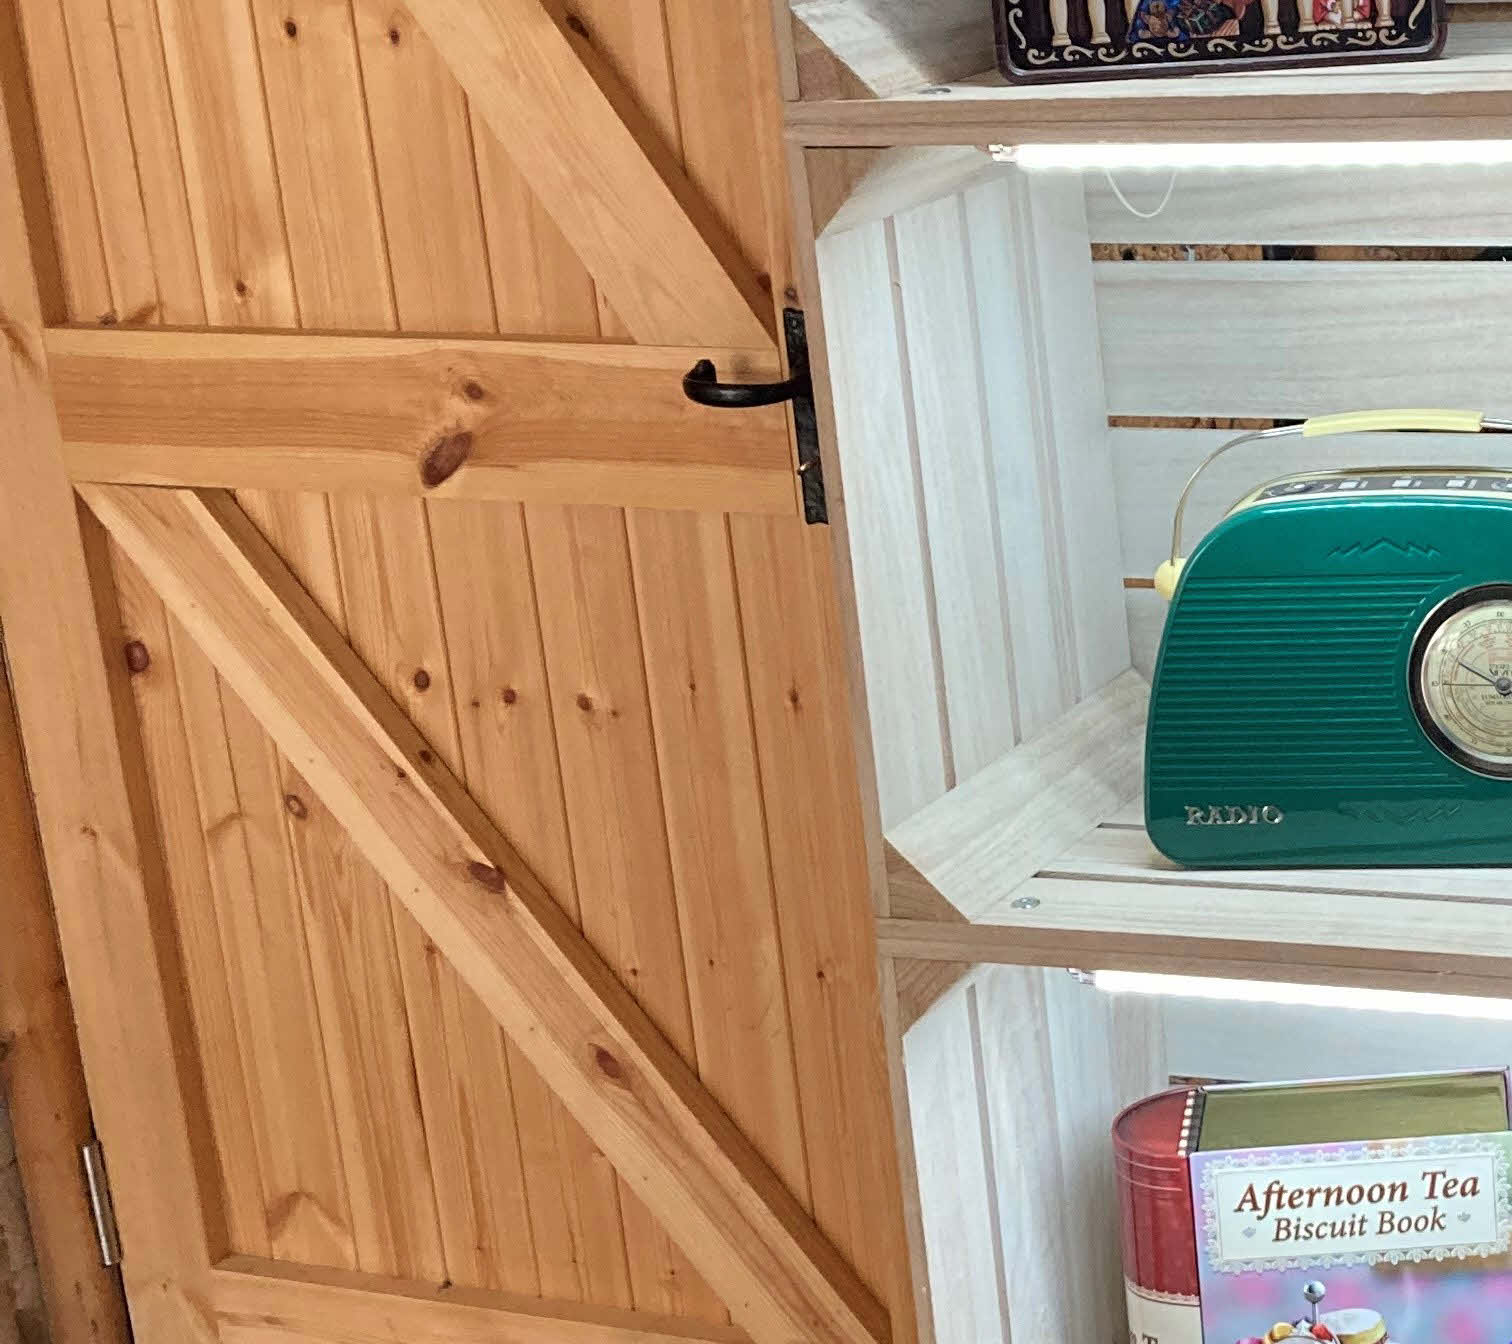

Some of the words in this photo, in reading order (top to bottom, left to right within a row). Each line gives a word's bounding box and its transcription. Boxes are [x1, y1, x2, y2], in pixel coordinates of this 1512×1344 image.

[1184, 805, 1284, 826] RADIO
[1233, 1180, 1410, 1221] Afternoon
[1421, 1169, 1481, 1200] Tea
[1272, 1212, 1368, 1243] Biscuit
[1376, 1205, 1448, 1236] Book
